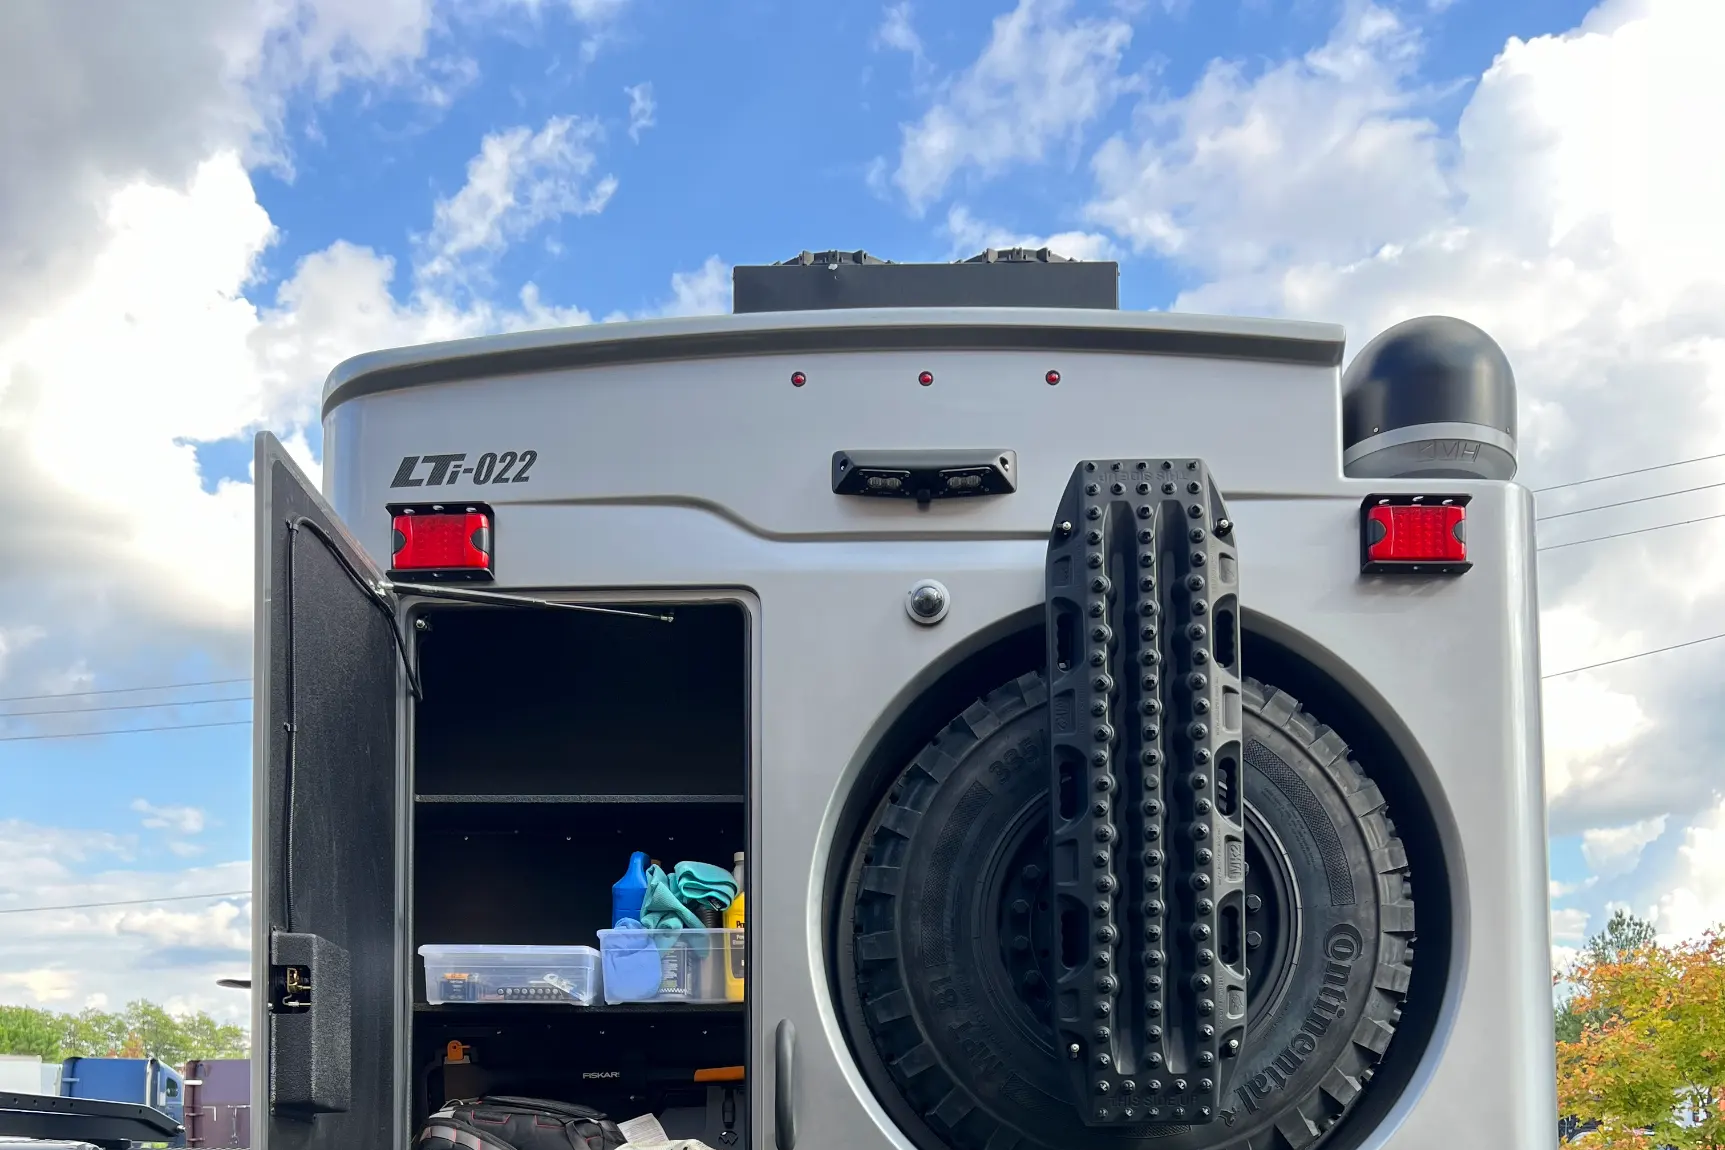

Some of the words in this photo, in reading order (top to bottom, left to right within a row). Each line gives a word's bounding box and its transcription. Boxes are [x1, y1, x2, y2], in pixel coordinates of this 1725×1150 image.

[390, 450, 538, 488] LTi-022
[1234, 923, 1364, 1115] Continental
[1107, 1095, 1141, 1107] THIS
[1143, 1095, 1177, 1107] SIDE
[1179, 1094, 1198, 1106] UP
